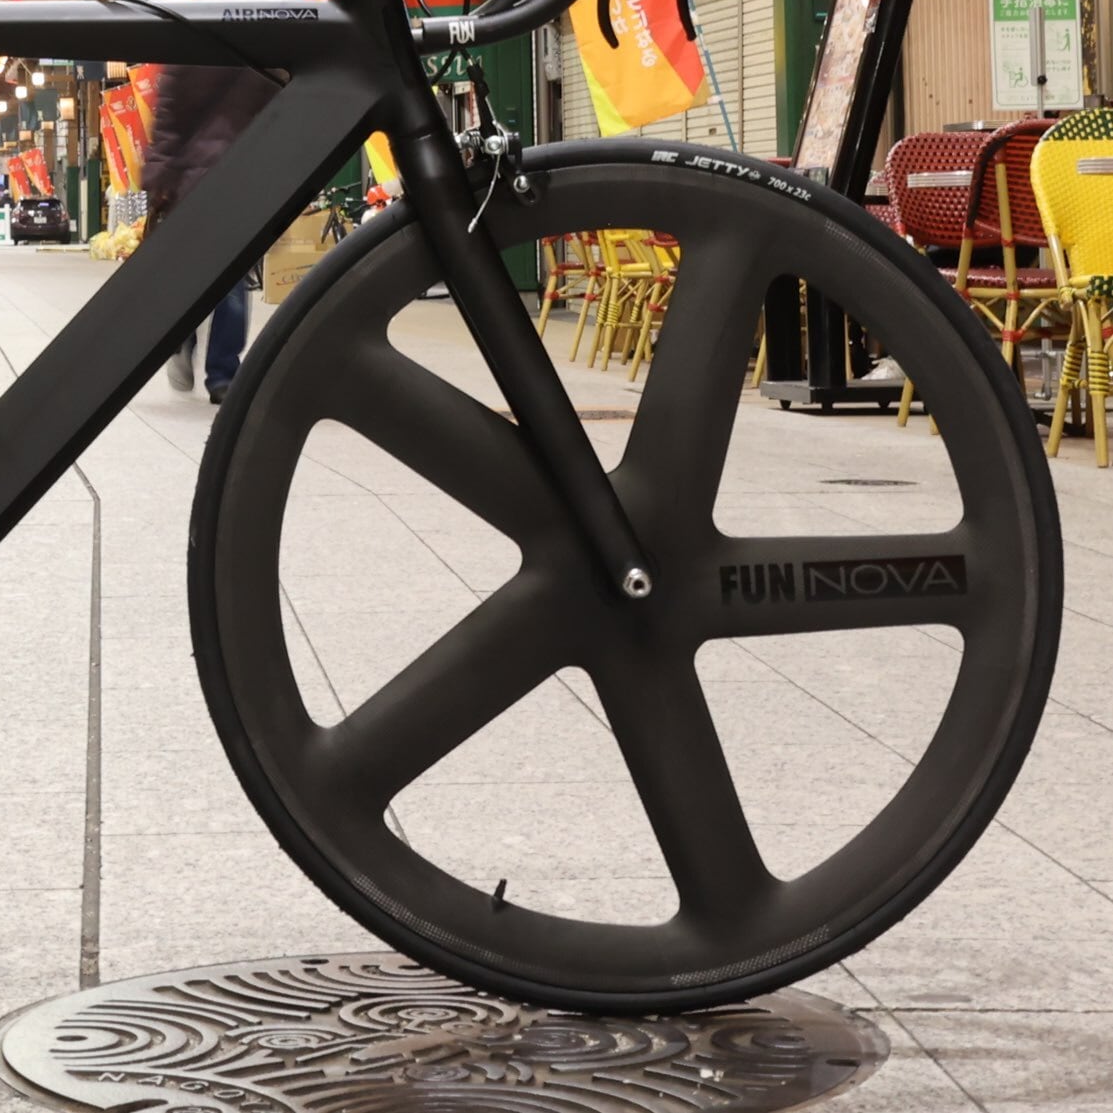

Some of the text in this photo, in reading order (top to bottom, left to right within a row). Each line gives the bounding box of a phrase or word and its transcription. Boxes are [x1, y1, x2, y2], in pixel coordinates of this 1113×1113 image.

[685, 155, 751, 177] JETTY
[719, 560, 961, 605] FUN NOVA
